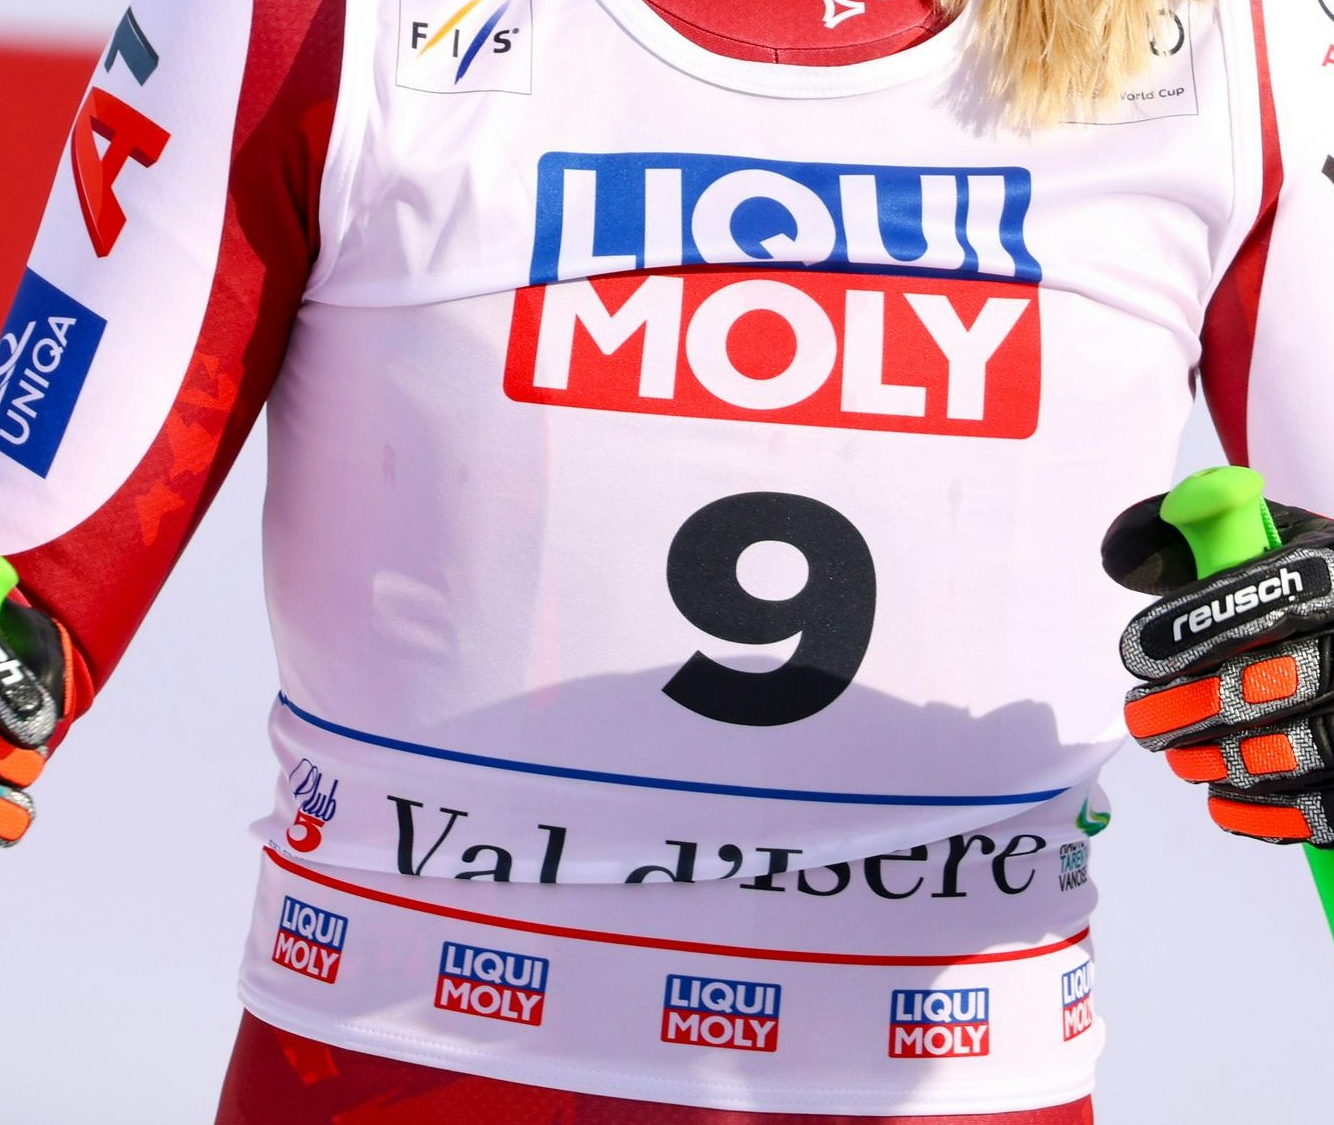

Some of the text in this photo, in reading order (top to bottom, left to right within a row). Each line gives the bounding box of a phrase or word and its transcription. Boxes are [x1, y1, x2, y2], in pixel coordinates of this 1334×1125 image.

[1158, 87, 1185, 98] Cup
[71, 6, 171, 259] A1
[557, 167, 1016, 280] LIQUI
[533, 275, 1031, 421] MOLY
[661, 491, 876, 726] 9
[1172, 567, 1303, 642] reusch
[387, 795, 566, 884] Val
[282, 899, 344, 948] LIQUI
[275, 932, 340, 979] MOLY
[444, 945, 543, 989] LIQUI
[440, 979, 542, 1022] MOLY
[670, 978, 776, 1015] LIQUI
[1063, 963, 1092, 1004] LIQU
[896, 991, 986, 1023] LIQUI
[1065, 996, 1093, 1038] MOL
[667, 1012, 776, 1049] MOLY
[894, 1025, 987, 1055] MOLY
